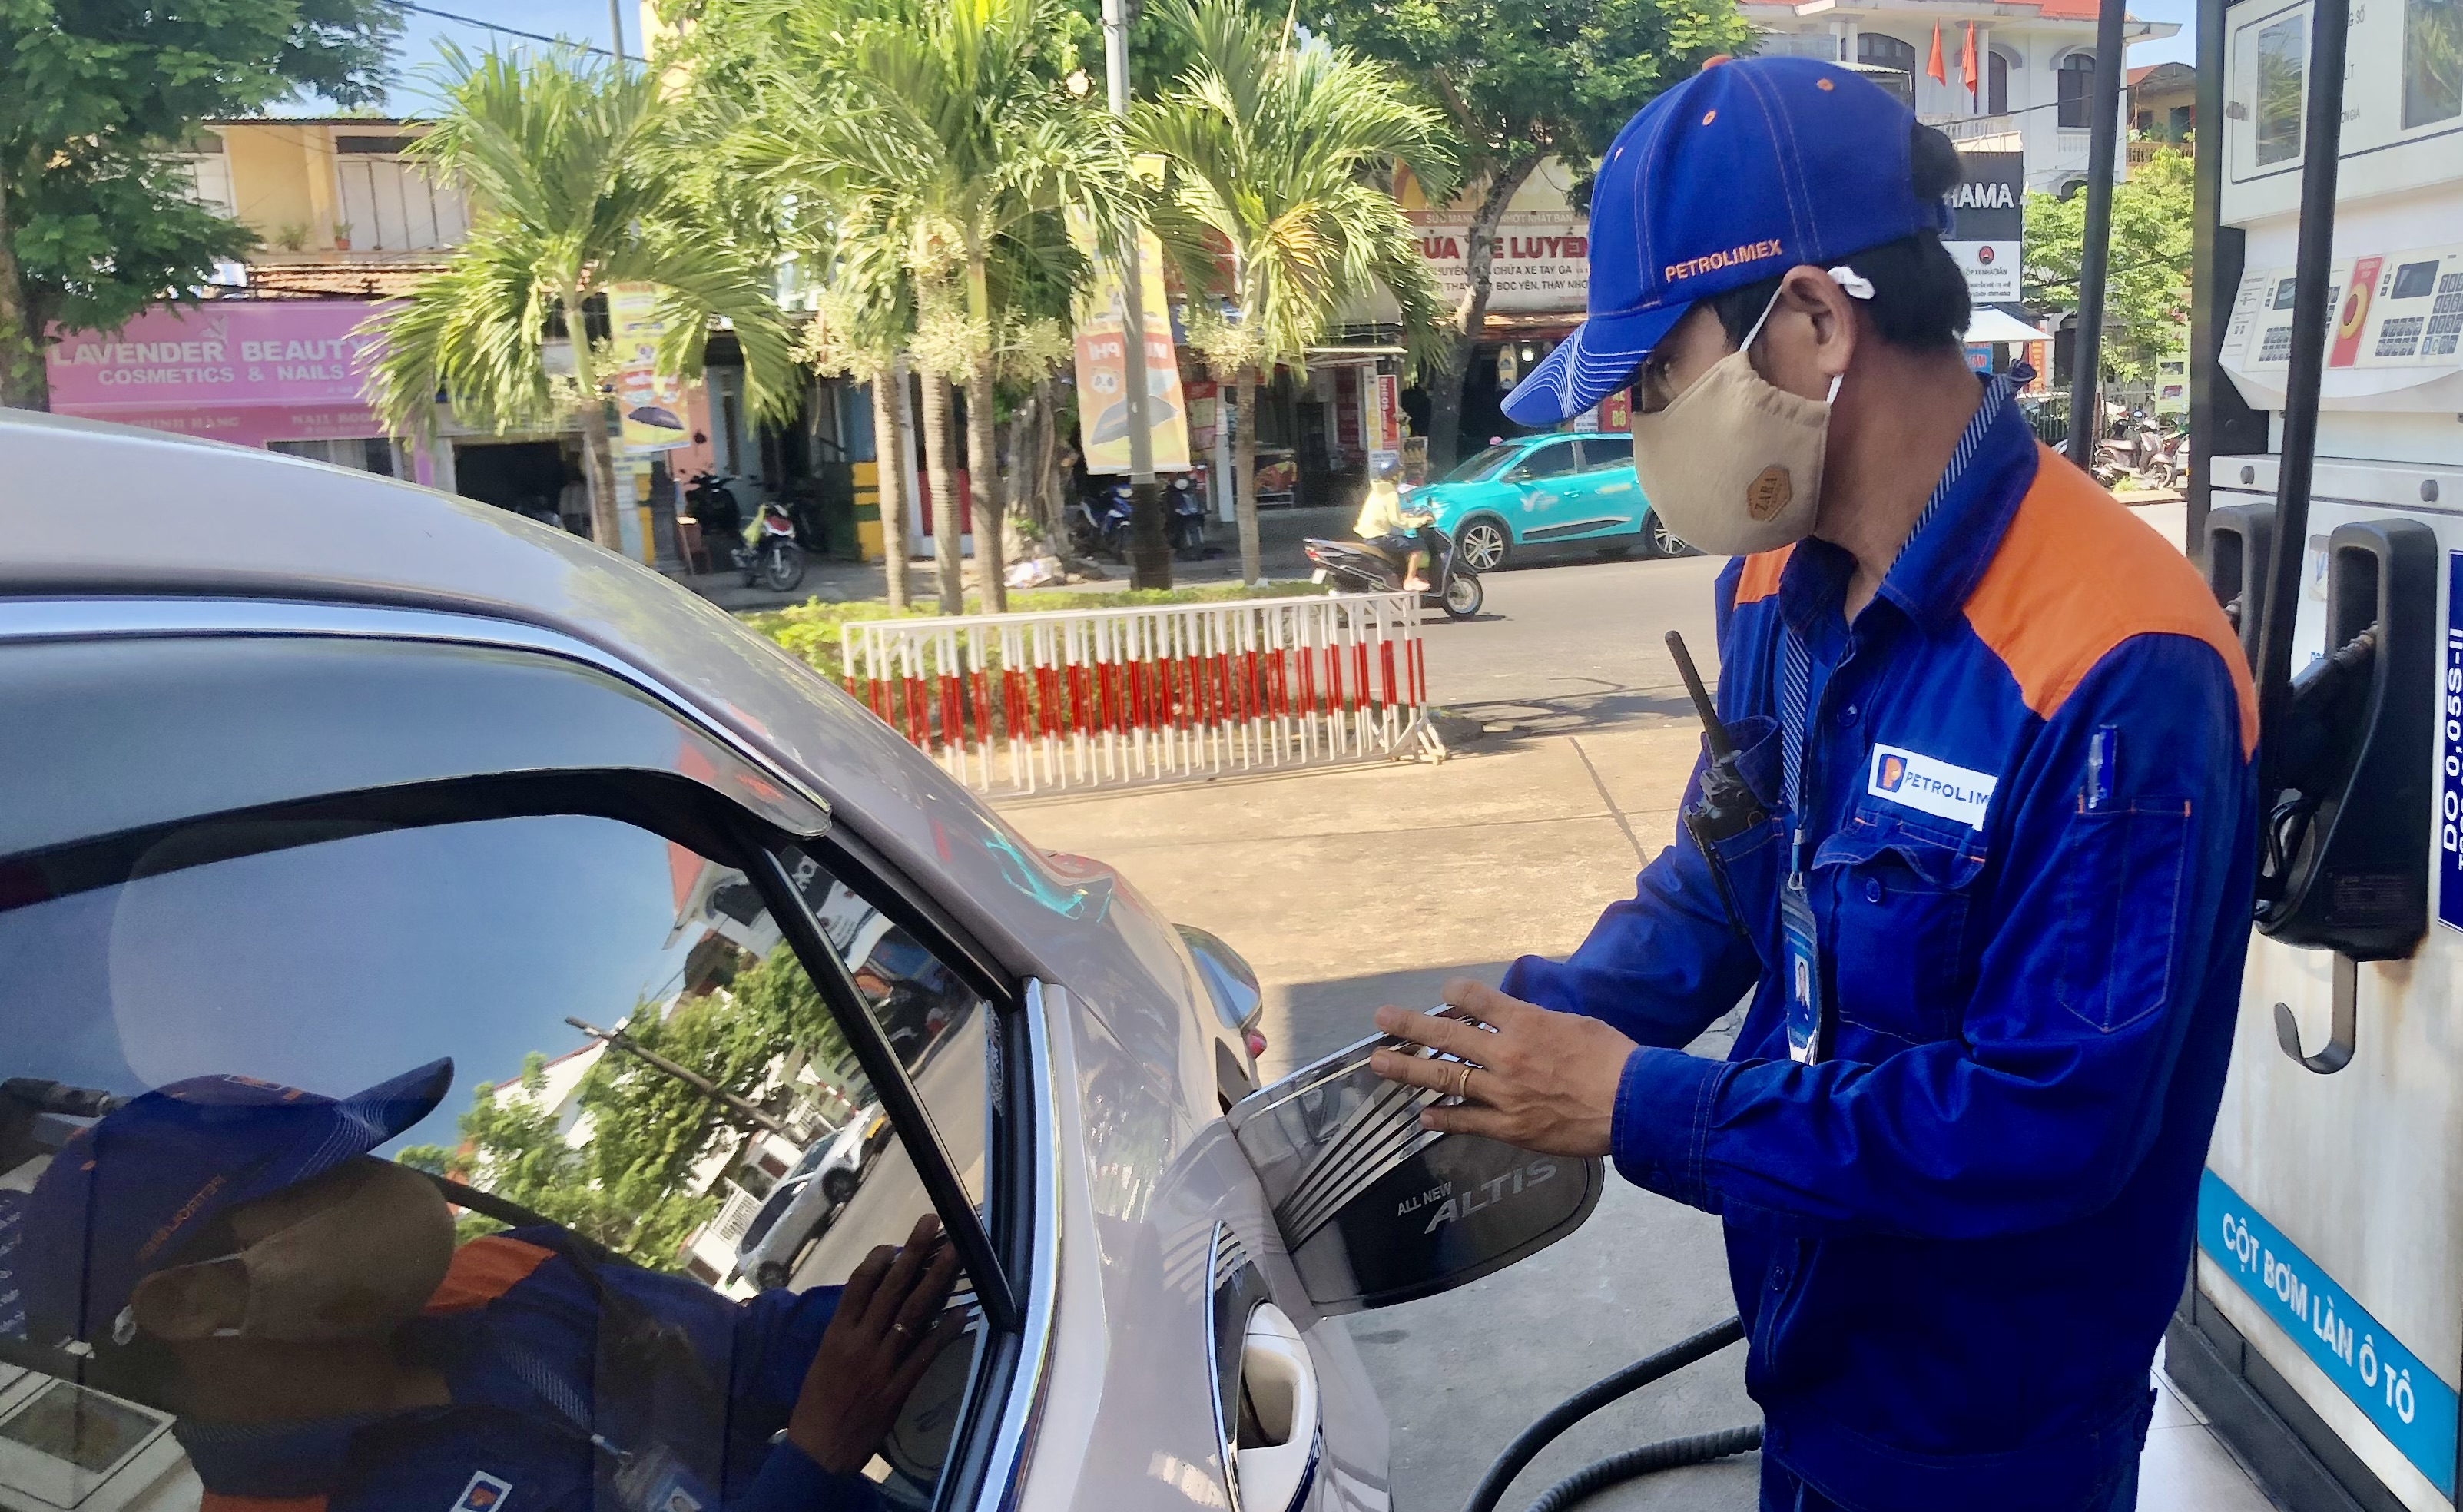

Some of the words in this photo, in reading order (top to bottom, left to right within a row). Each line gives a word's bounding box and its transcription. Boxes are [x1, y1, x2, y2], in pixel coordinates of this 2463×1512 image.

[1414, 229, 1460, 259] ỬA
[1665, 238, 1782, 283] PETROLIMEX
[1525, 266, 1536, 274] XE
[1540, 266, 1556, 274] TAY
[1559, 265, 1572, 274] GA
[1542, 281, 1565, 290] THAY
[51, 340, 226, 366] LAVENDER
[98, 366, 234, 385] COSMETICS
[247, 366, 265, 382] &
[277, 363, 345, 381] NAILS
[2443, 790, 2458, 853] DO
[1397, 1196, 1421, 1217] ALL
[1423, 1181, 1452, 1205] NEW
[1424, 1156, 1558, 1235] ALTIS
[2223, 1212, 2259, 1273] CỘT
[2263, 1248, 2308, 1322] BƠM
[2313, 1295, 2354, 1367] LÀN
[2359, 1333, 2378, 1388] Ô
[2384, 1362, 2415, 1424] TÔ
